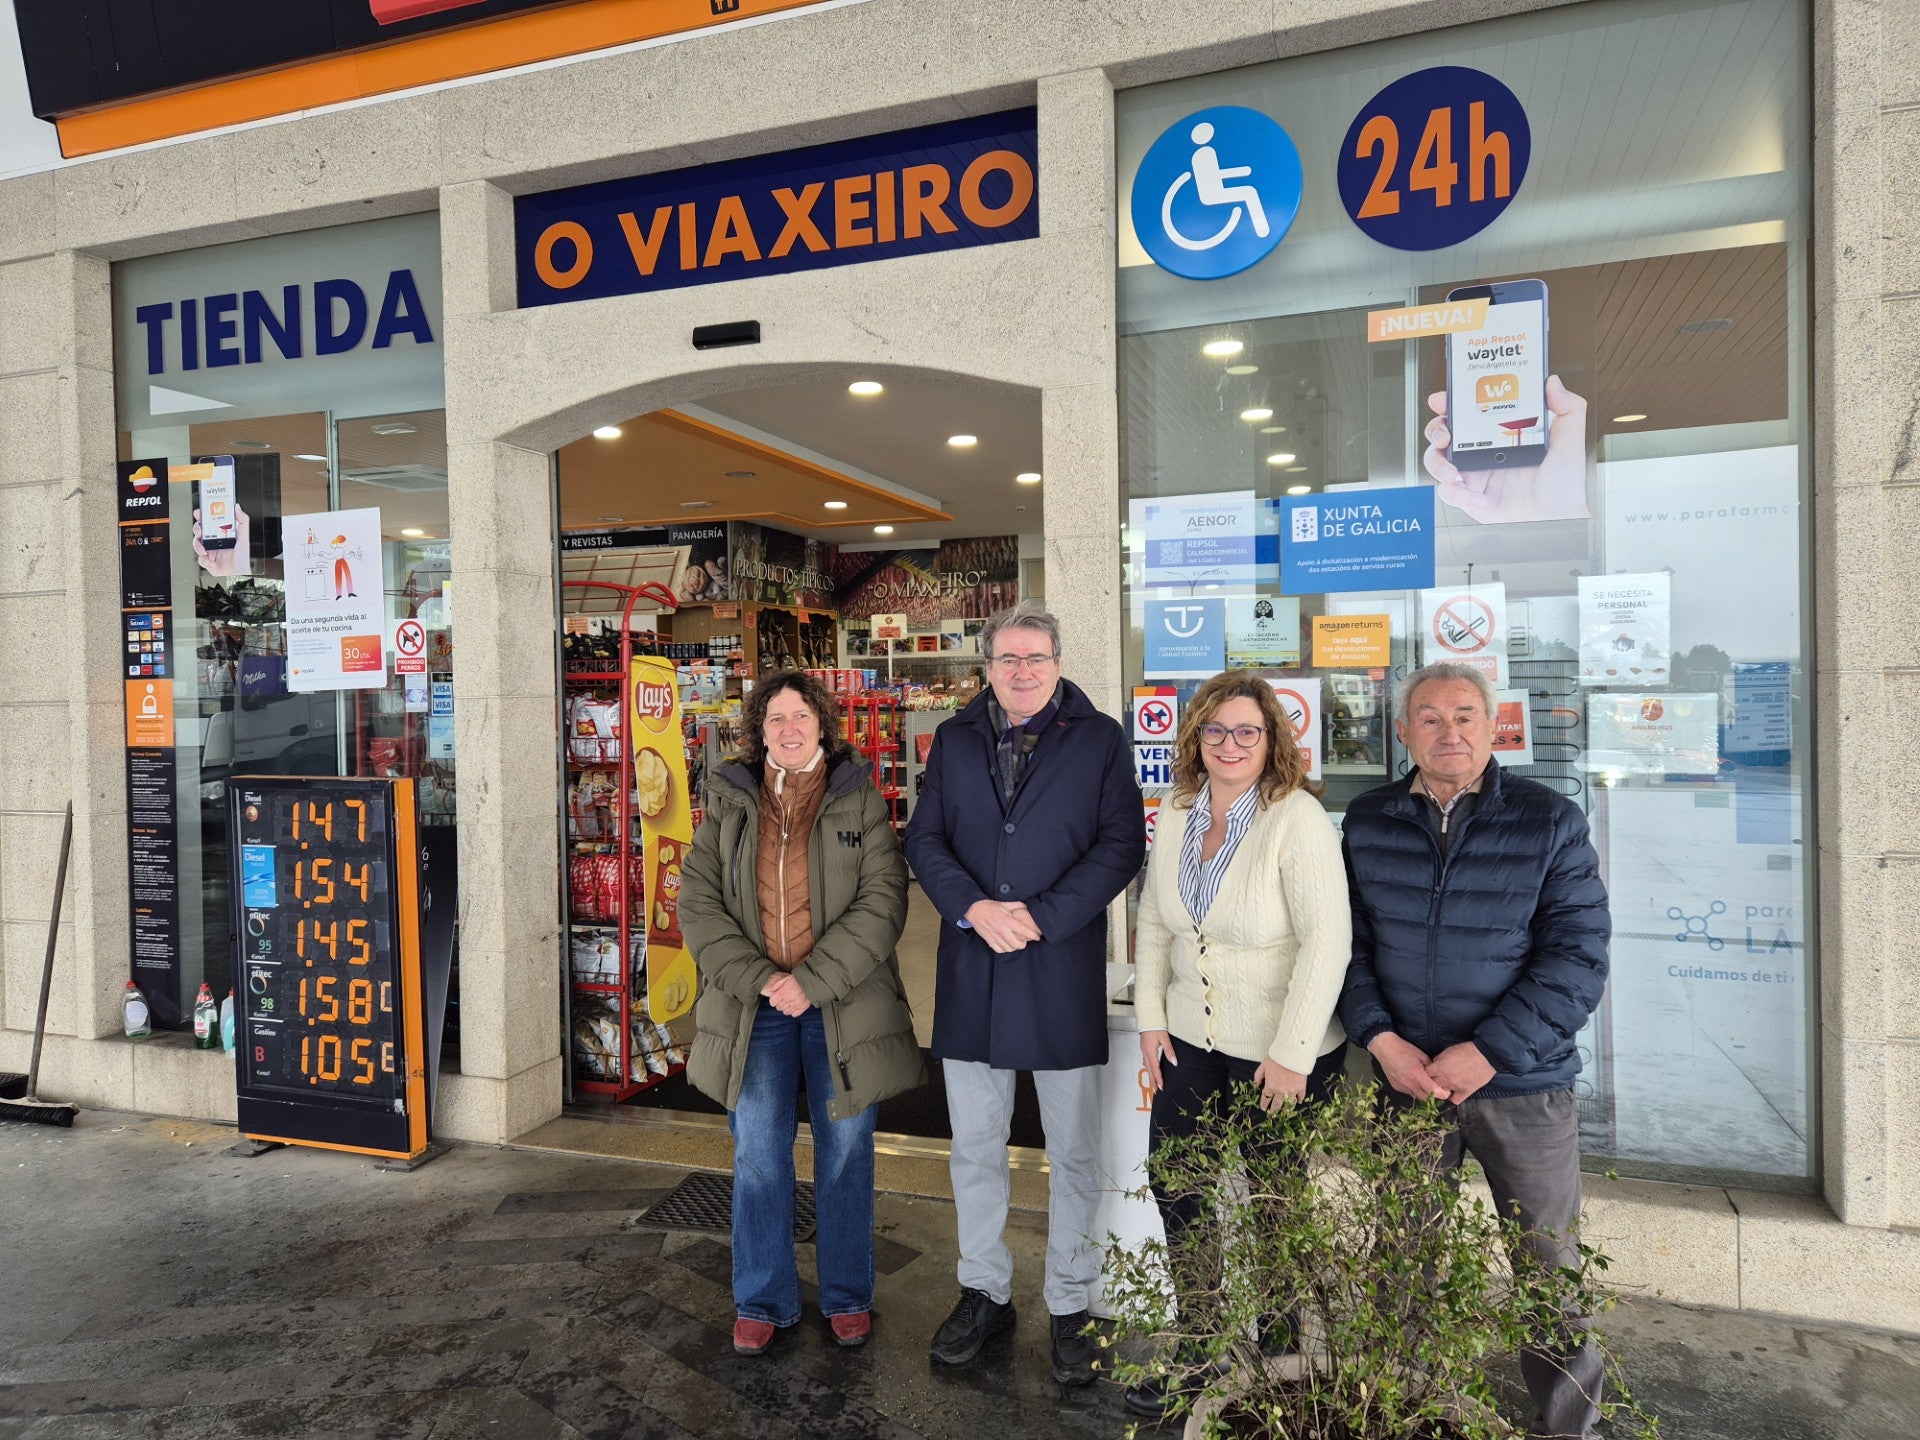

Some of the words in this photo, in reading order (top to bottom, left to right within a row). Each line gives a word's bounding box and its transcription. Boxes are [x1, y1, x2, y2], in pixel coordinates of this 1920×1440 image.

[1355, 101, 1511, 220] 24h
[534, 220, 594, 289] O
[617, 150, 1034, 276] VIAXEIRO
[136, 268, 434, 375] TIENDA
[1380, 306, 1473, 337] ¡NUEVA!
[1467, 337, 1488, 347] App
[1491, 333, 1527, 345] Repsol
[1467, 344, 1522, 361] waylet
[126, 496, 162, 507] REPSOL
[1323, 505, 1383, 521] XUNTA
[1187, 514, 1237, 528] AENOR
[1323, 523, 1345, 538] DE
[1350, 518, 1422, 536] GALICIA
[672, 526, 724, 541] PANADERÍA
[563, 538, 571, 547] Y
[571, 536, 613, 548] REVISTAS
[1187, 539, 1219, 548] REPSOL
[1187, 549, 1213, 557] CALIDAD
[1213, 548, 1249, 556] COMERCIAL
[735, 558, 799, 587] PRODUCTOS
[1593, 591, 1605, 600] SE
[1607, 589, 1653, 599] NECESITA
[1597, 600, 1649, 610] PERSONAL
[290, 617, 300, 625] Da
[314, 615, 344, 625] segunda
[344, 613, 360, 621] vida
[1319, 622, 1351, 630] amazon
[1351, 621, 1384, 629] returns
[291, 626, 312, 634] aceite
[330, 624, 353, 632] cocina
[344, 647, 360, 660] 30
[242, 671, 267, 686] Milka
[435, 684, 451, 693] VISA
[435, 700, 451, 709] VISA
[638, 682, 672, 720] Lay's
[244, 794, 262, 802] Diesel
[291, 799, 366, 850] 1.47
[837, 831, 862, 848] HH
[244, 852, 266, 862] Diesel
[293, 858, 368, 909] 1.54
[249, 911, 271, 920] efitec
[258, 939, 272, 951] 95
[296, 918, 370, 968] 1.45
[251, 970, 273, 979] efitec
[1667, 965, 1748, 982] Cuidamos
[1751, 970, 1772, 983] de
[1775, 971, 1788, 984] ti
[260, 997, 274, 1010] 98
[298, 976, 373, 1027] 1.58
[254, 1027, 276, 1037] Gasóleo
[254, 1045, 265, 1063] B
[301, 1034, 374, 1085] 1.05
